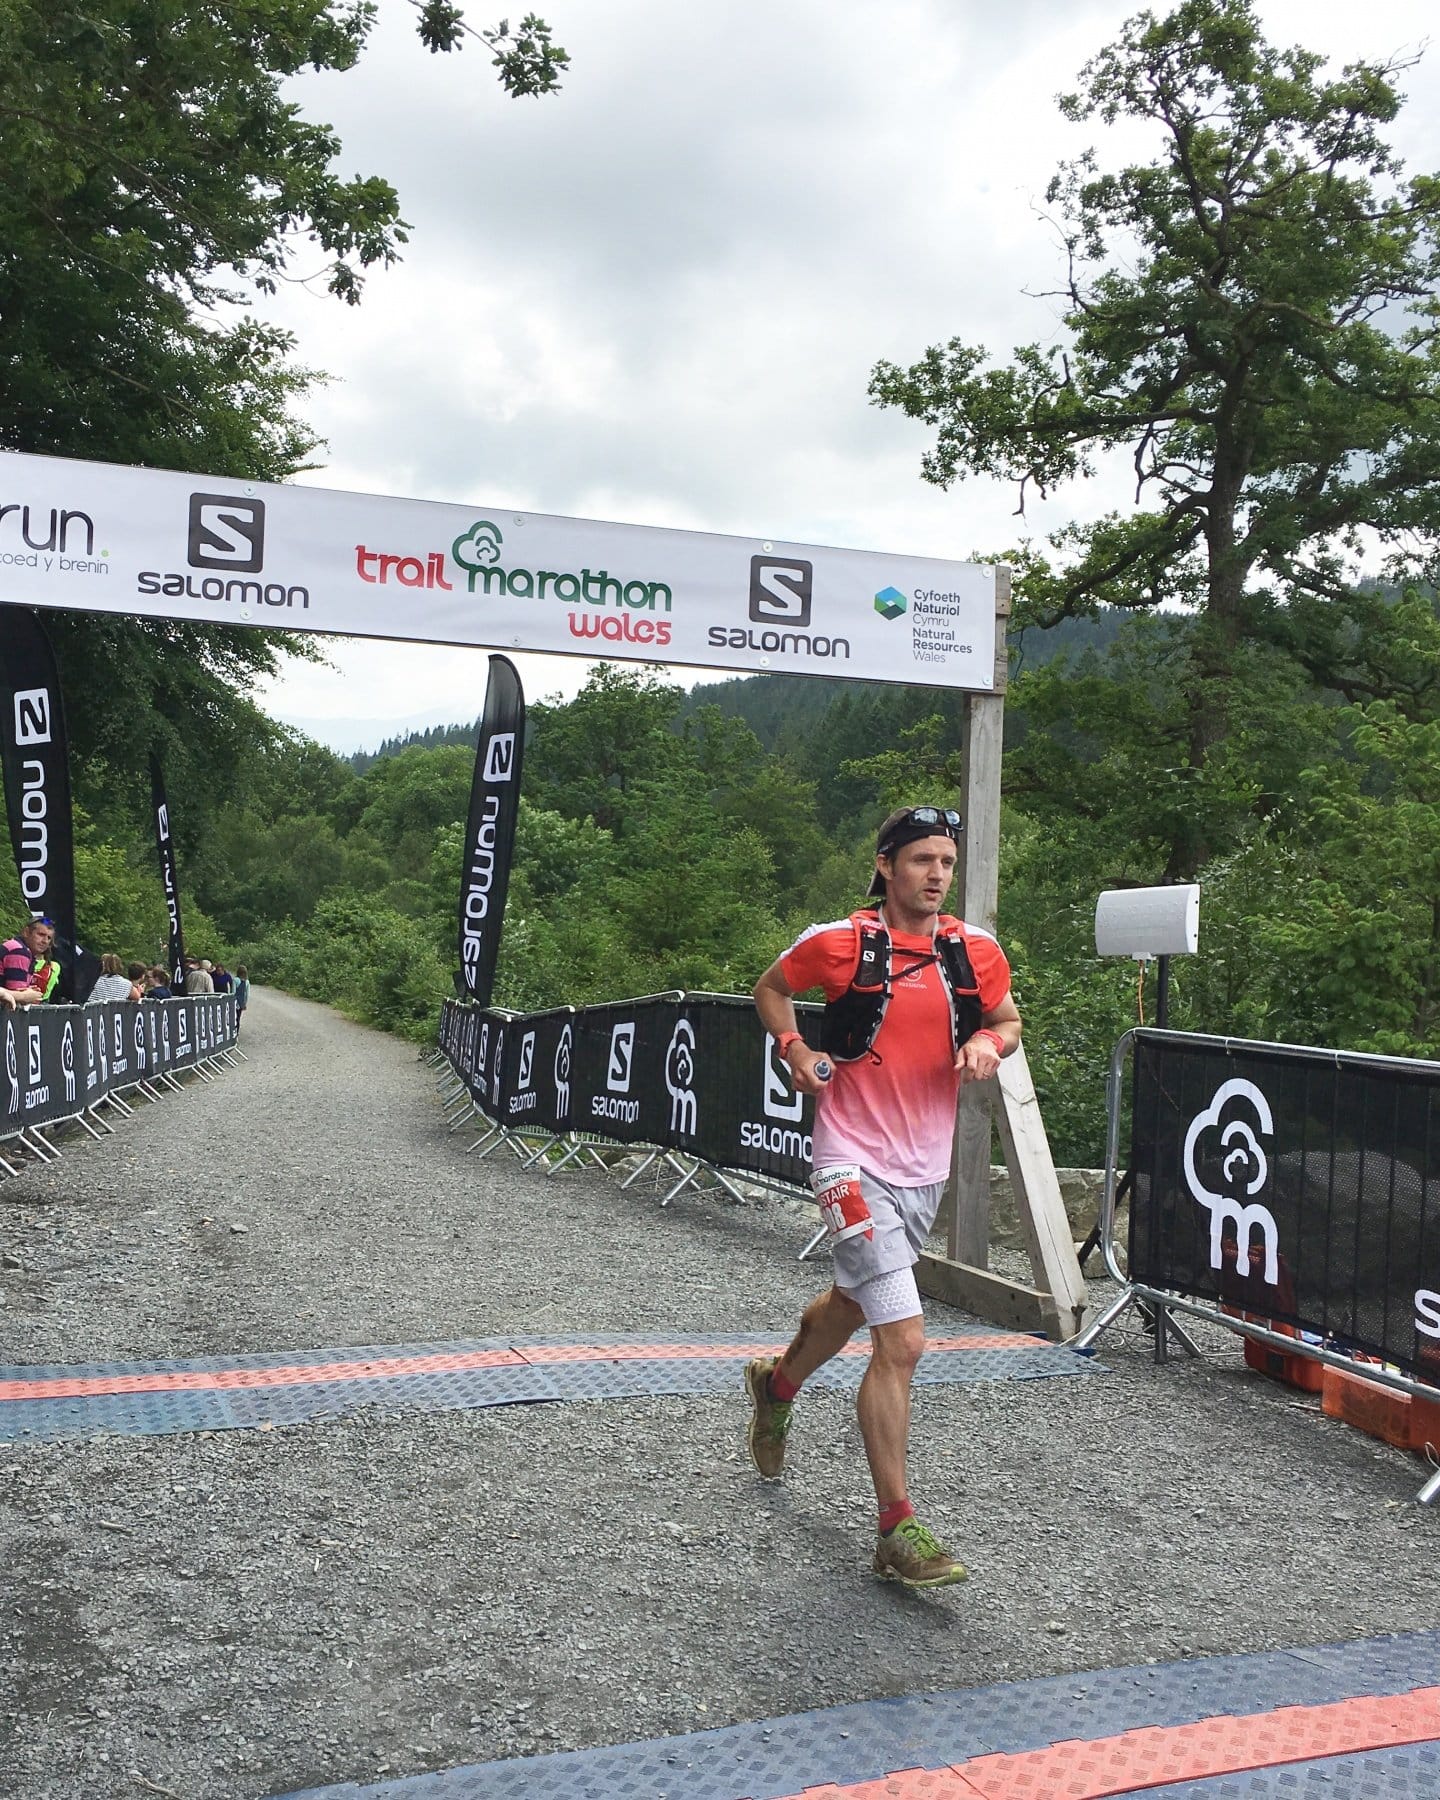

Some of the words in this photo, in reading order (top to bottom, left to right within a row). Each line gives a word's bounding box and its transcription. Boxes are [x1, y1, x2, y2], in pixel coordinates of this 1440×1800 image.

[43, 557, 54, 572] y
[59, 556, 109, 574] brenin
[355, 545, 453, 591] trail
[466, 563, 673, 612] marathon
[137, 571, 310, 609] salomon
[913, 588, 961, 604] Cyfoeth
[912, 601, 961, 617] Naturiol
[567, 612, 673, 646] wales
[912, 613, 950, 627] Cymru
[708, 626, 851, 659] salomon
[912, 627, 955, 641] Natural
[912, 638, 973, 654] Resources
[912, 650, 947, 663] Wales
[509, 1091, 537, 1114] salomon
[591, 1095, 640, 1124] salomon
[740, 1121, 813, 1163] salomo
